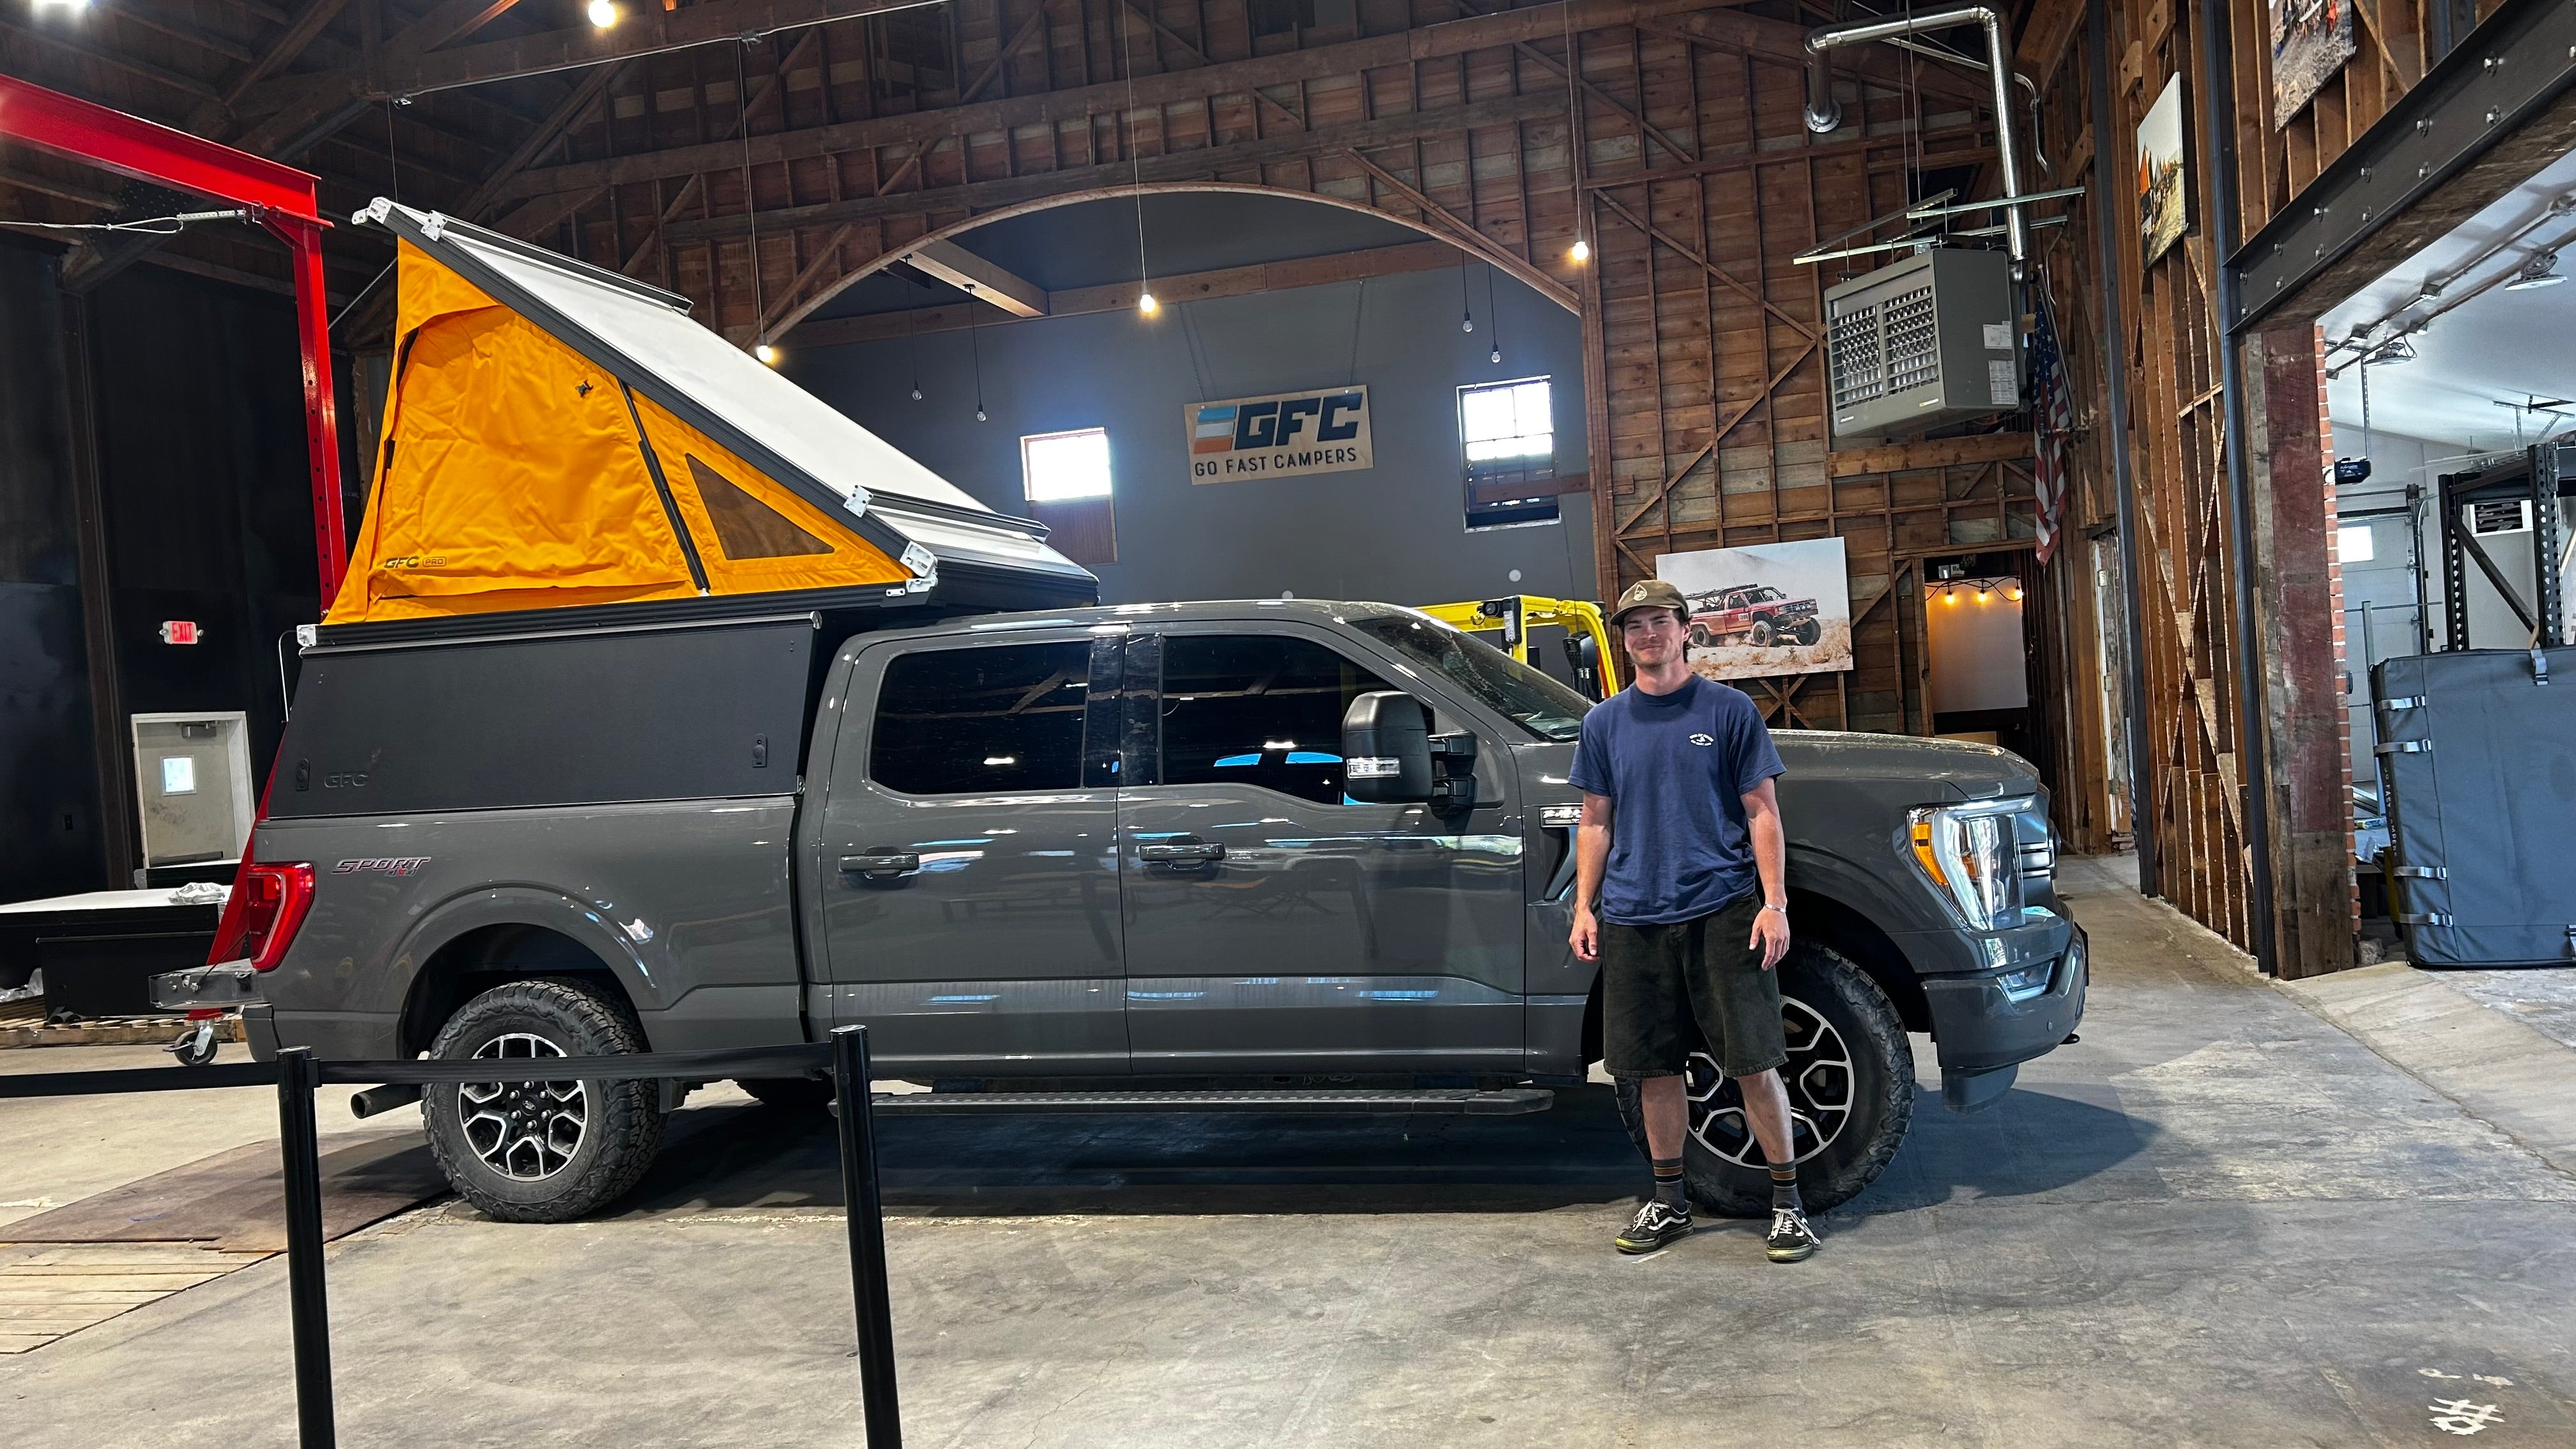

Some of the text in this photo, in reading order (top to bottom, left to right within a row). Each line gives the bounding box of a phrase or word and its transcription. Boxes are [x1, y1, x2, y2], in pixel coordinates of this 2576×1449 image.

[1234, 393, 1363, 450] GFC
[1195, 447, 1357, 477] GO FAST CAMPERS
[384, 556, 419, 568] GFC
[172, 622, 193, 642] EXIT
[324, 772, 368, 788] GFC
[331, 857, 432, 875] SPORT
